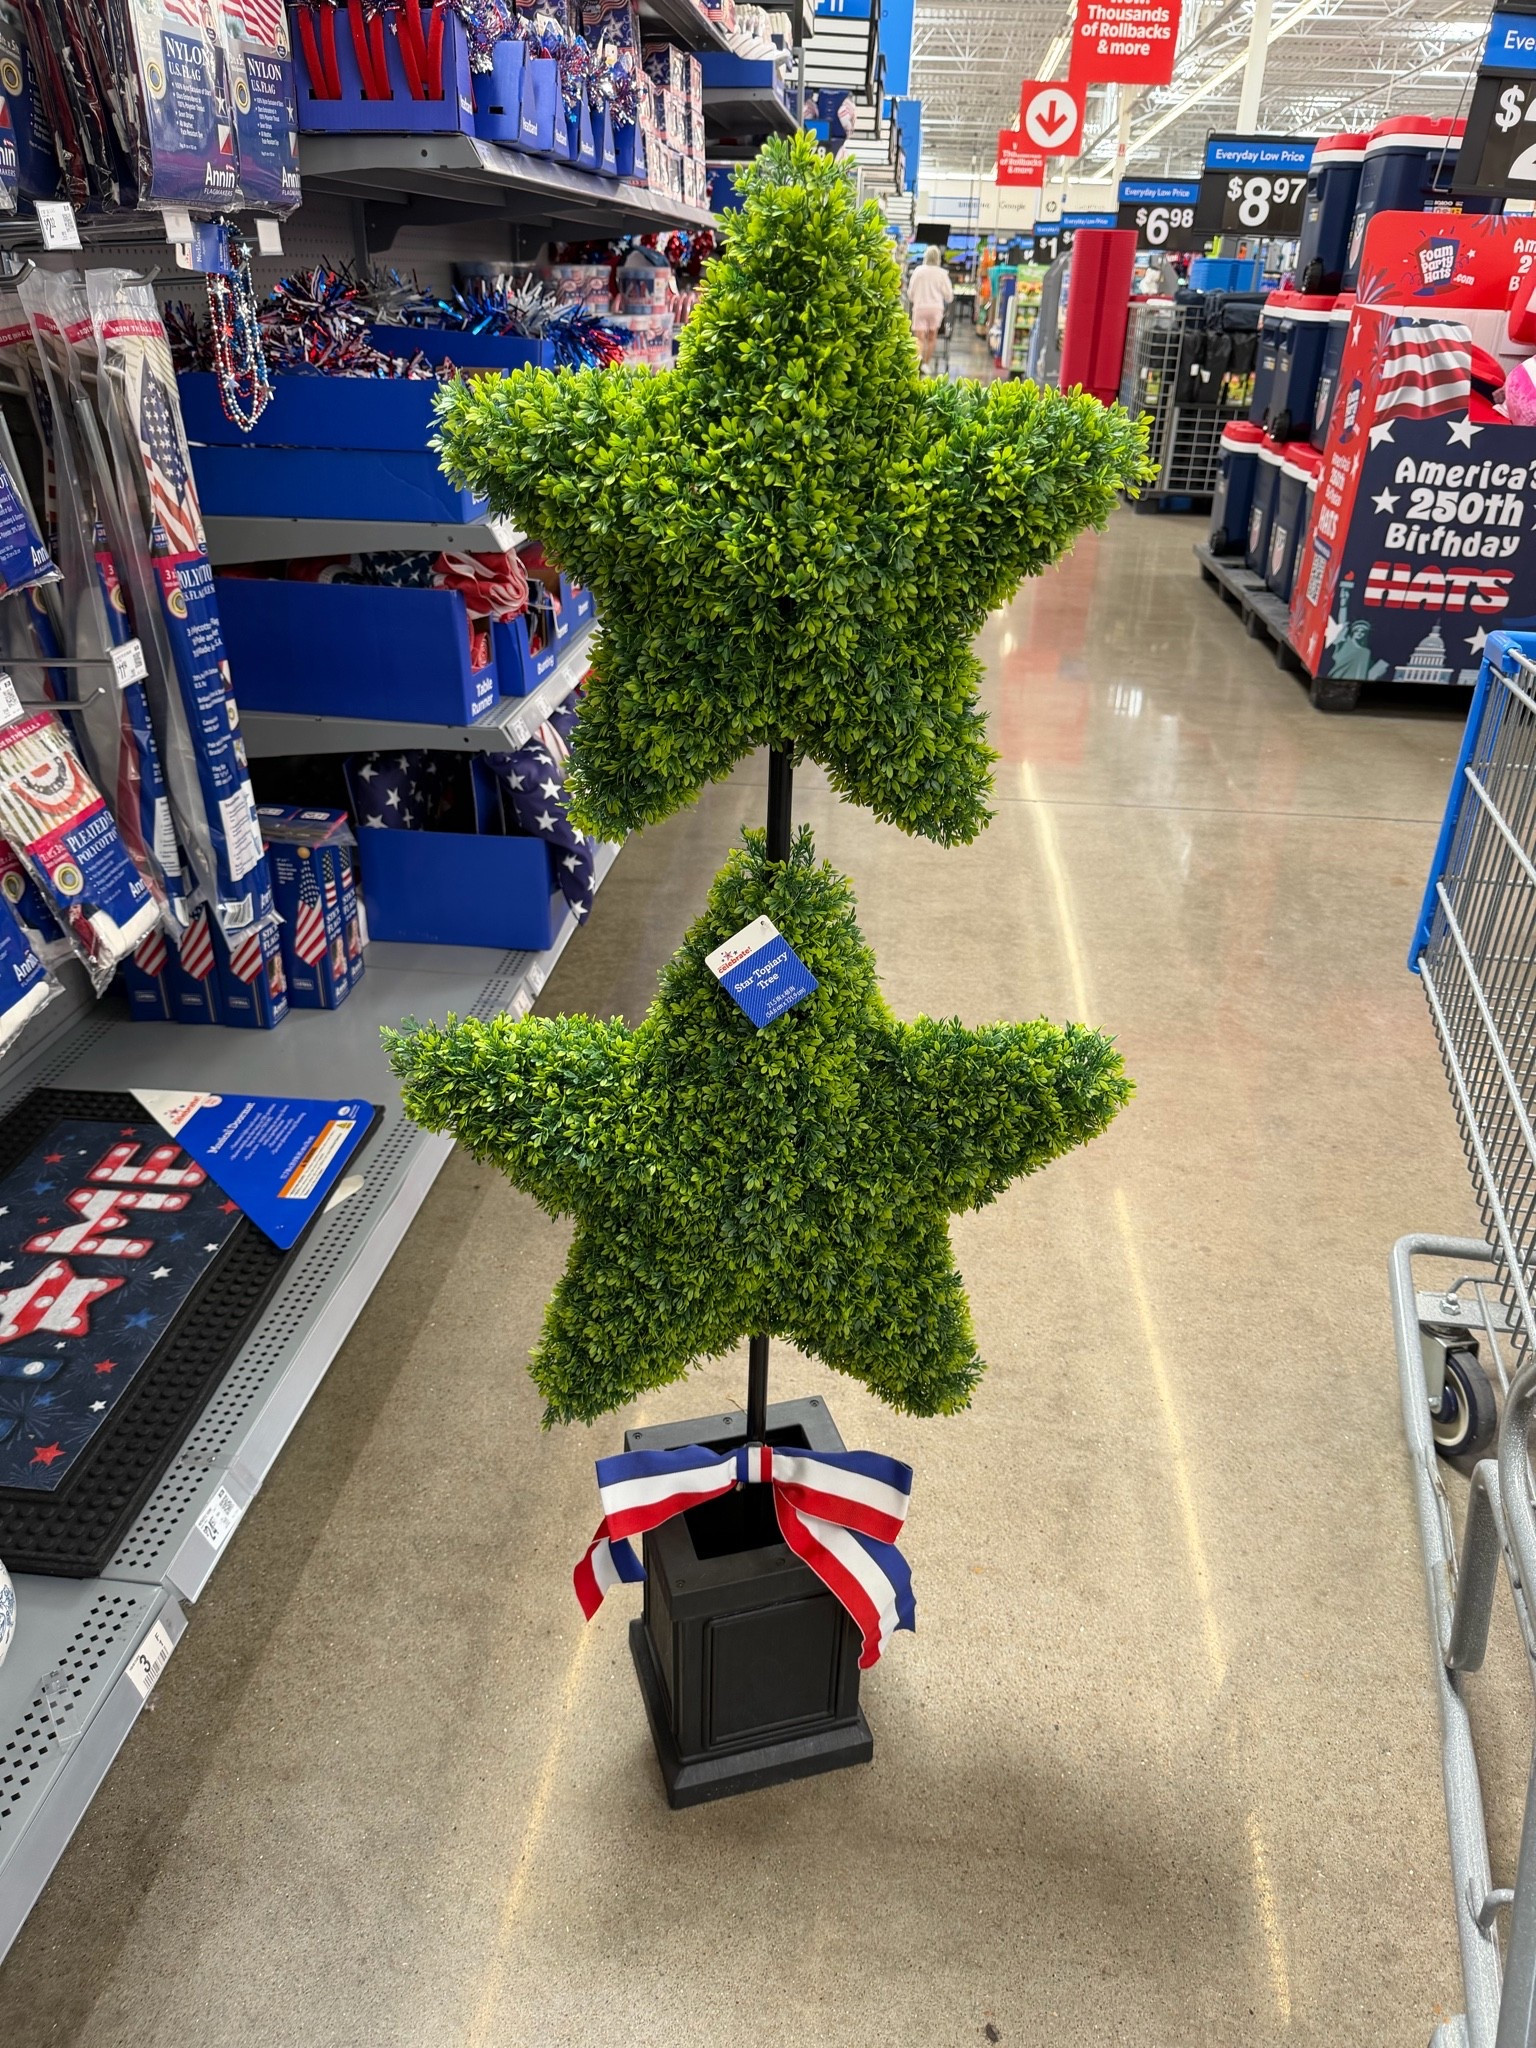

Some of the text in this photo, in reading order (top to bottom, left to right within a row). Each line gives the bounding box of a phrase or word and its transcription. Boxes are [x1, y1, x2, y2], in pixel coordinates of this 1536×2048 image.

[1087, 5, 1170, 22] Thousands
[1081, 21, 1171, 39] of Rollbacks
[164, 36, 210, 66] NYLON
[1097, 39, 1150, 55] & more
[182, 65, 201, 81] FLAG
[247, 57, 282, 81] NYLON
[261, 81, 276, 95] FLAG
[1215, 149, 1305, 163] Everyday Low Price
[205, 161, 235, 188] Annin
[204, 187, 233, 197] FLAGMAKERS
[1125, 187, 1190, 198] Everyday Low Price
[1419, 245, 1454, 264] Foam
[1421, 256, 1454, 274] Party
[1424, 268, 1451, 284] Hats
[1406, 487, 1524, 527] 250th
[1385, 523, 1521, 558] Birthday
[1364, 561, 1515, 614] HATS
[476, 678, 493, 697] Table
[471, 694, 494, 717] Runner
[66, 816, 107, 853] PLEATED
[717, 946, 752, 974] celebrate!
[734, 951, 788, 993] Star Topiary
[757, 973, 779, 989] Tree
